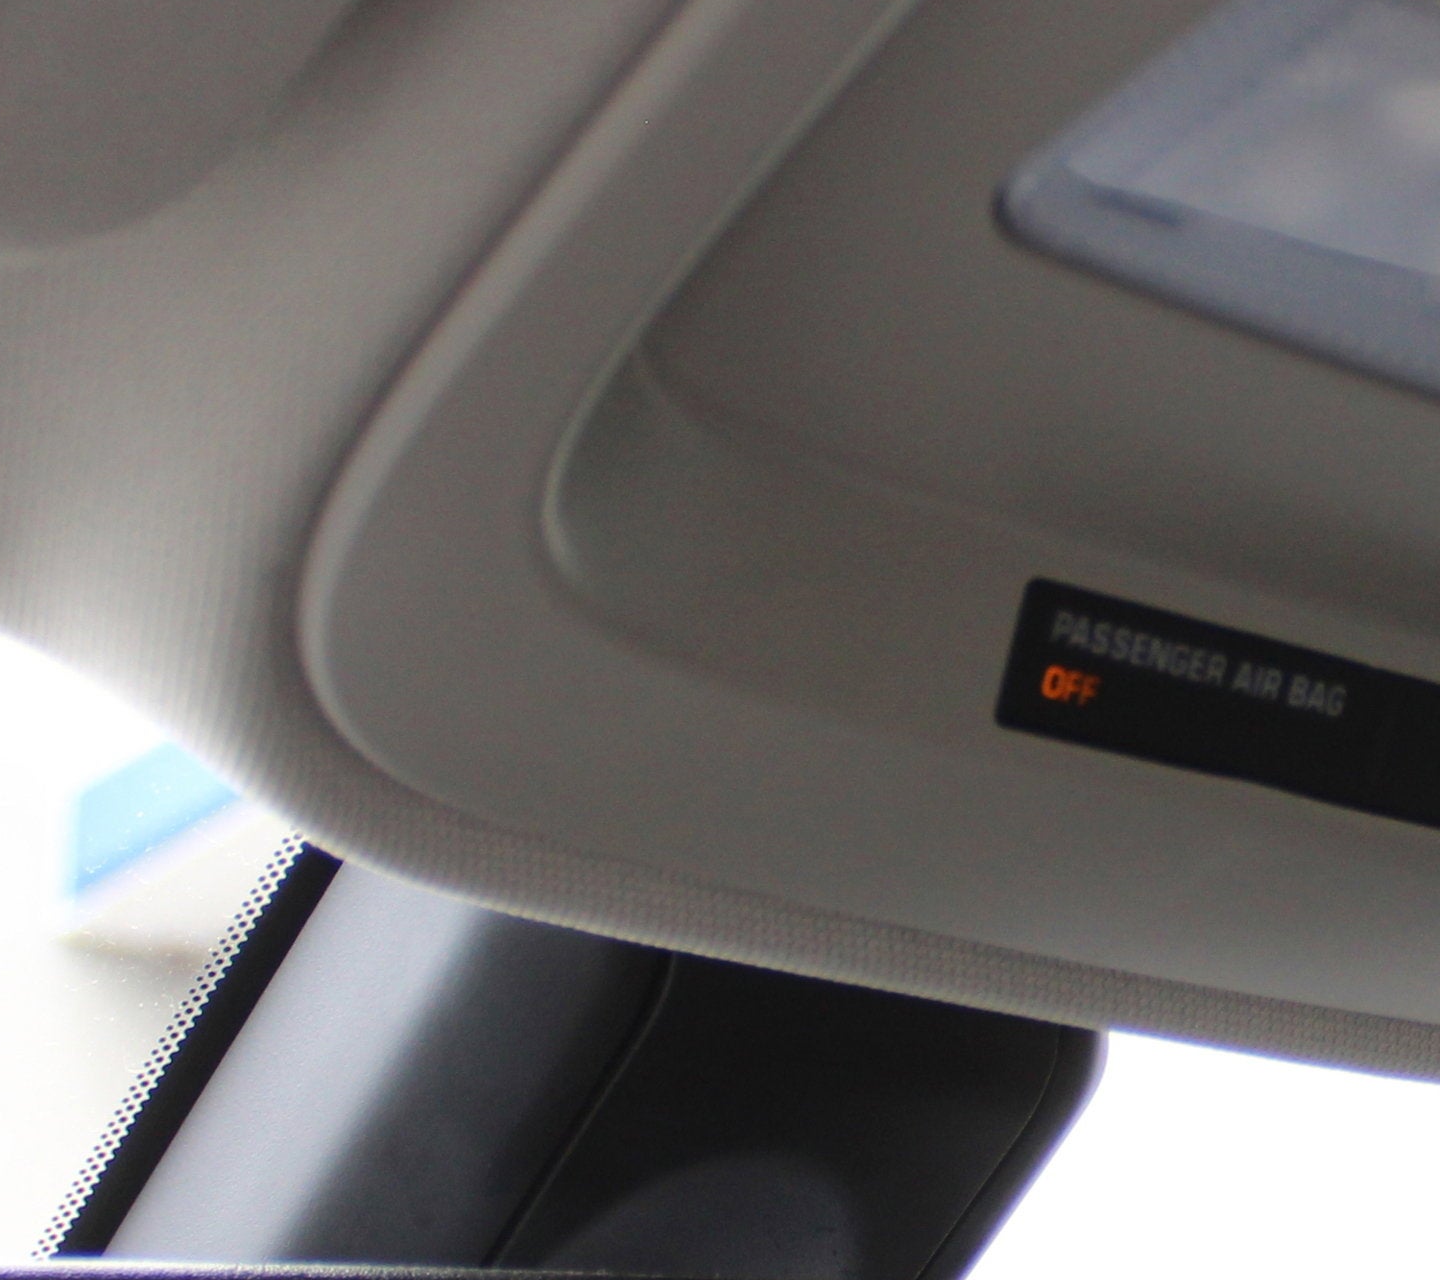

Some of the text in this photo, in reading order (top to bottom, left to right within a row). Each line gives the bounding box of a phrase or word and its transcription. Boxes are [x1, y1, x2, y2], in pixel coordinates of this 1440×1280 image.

[1040, 664, 1102, 707] OFF
[1050, 611, 1348, 717] PASSENGER AIR BAG
